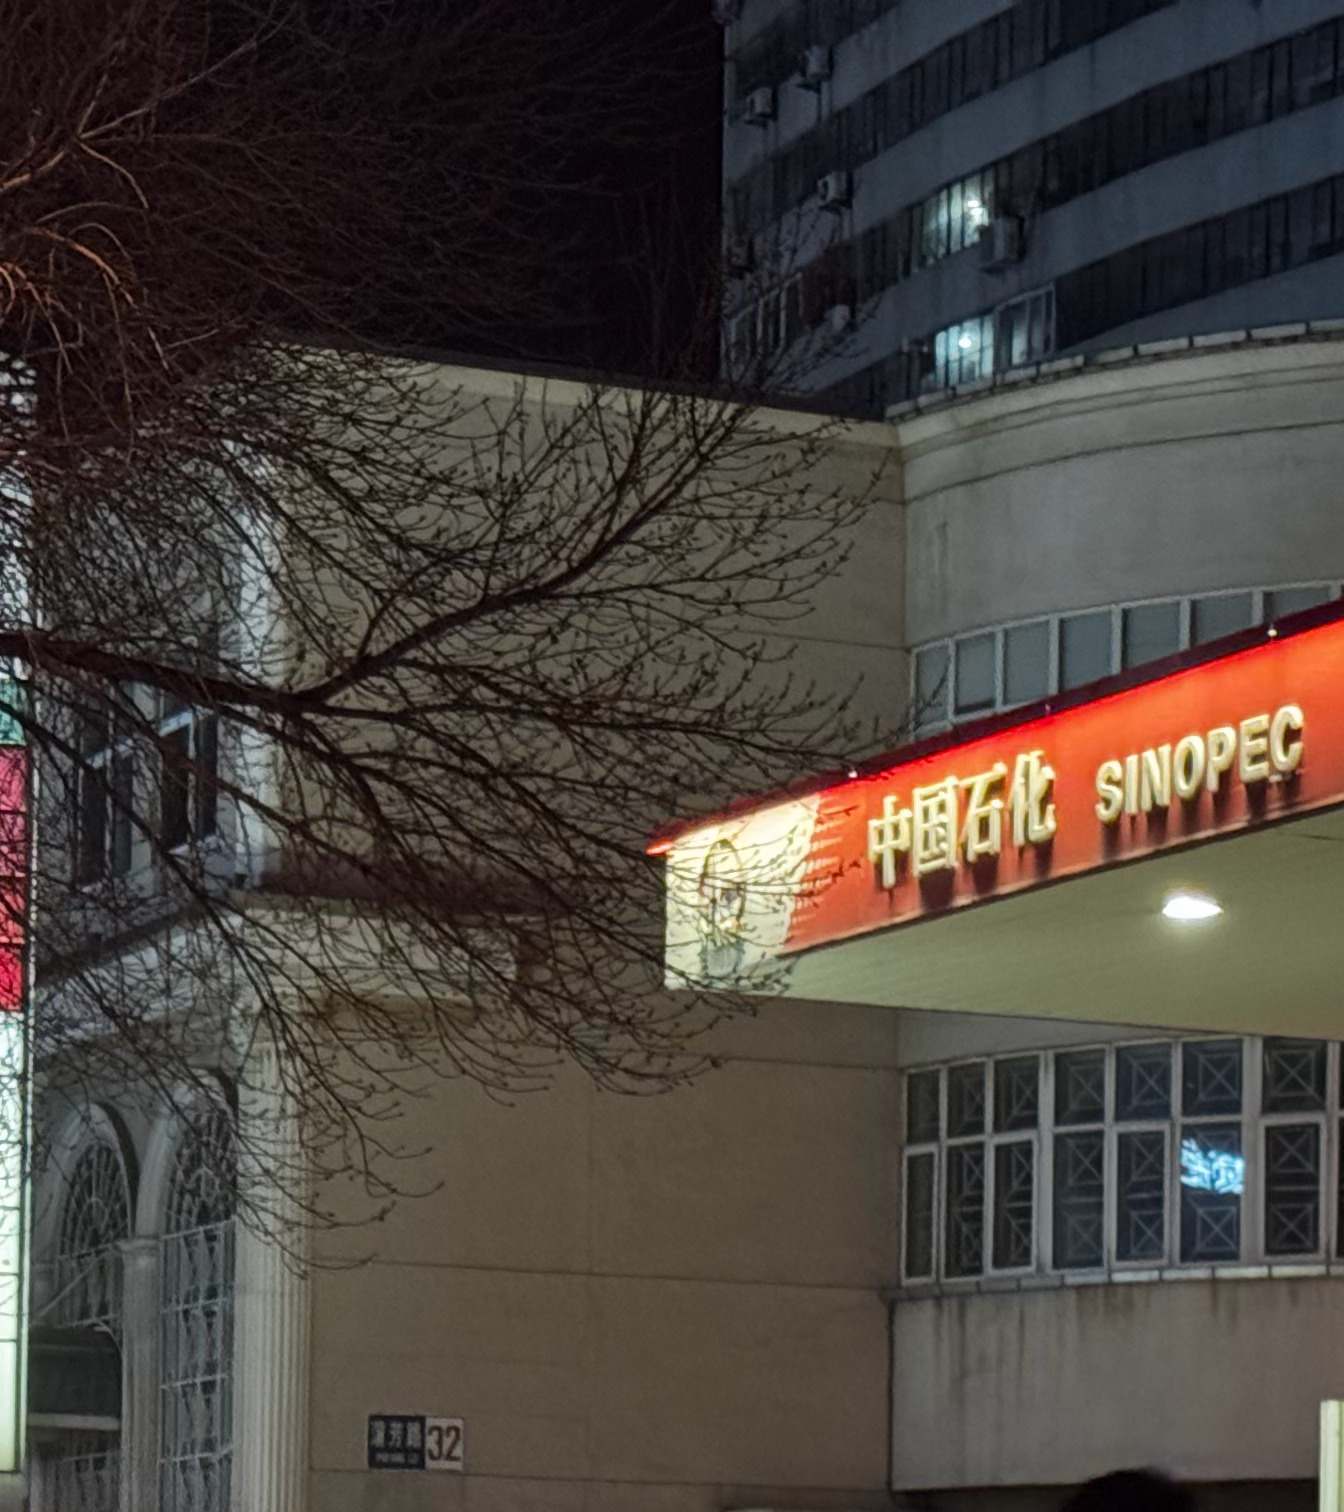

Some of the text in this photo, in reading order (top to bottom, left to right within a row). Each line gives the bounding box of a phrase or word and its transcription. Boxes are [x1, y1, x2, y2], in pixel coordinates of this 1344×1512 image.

[868, 703, 1305, 888] 中国石化 SINOPEC
[427, 1424, 462, 1462] 32
